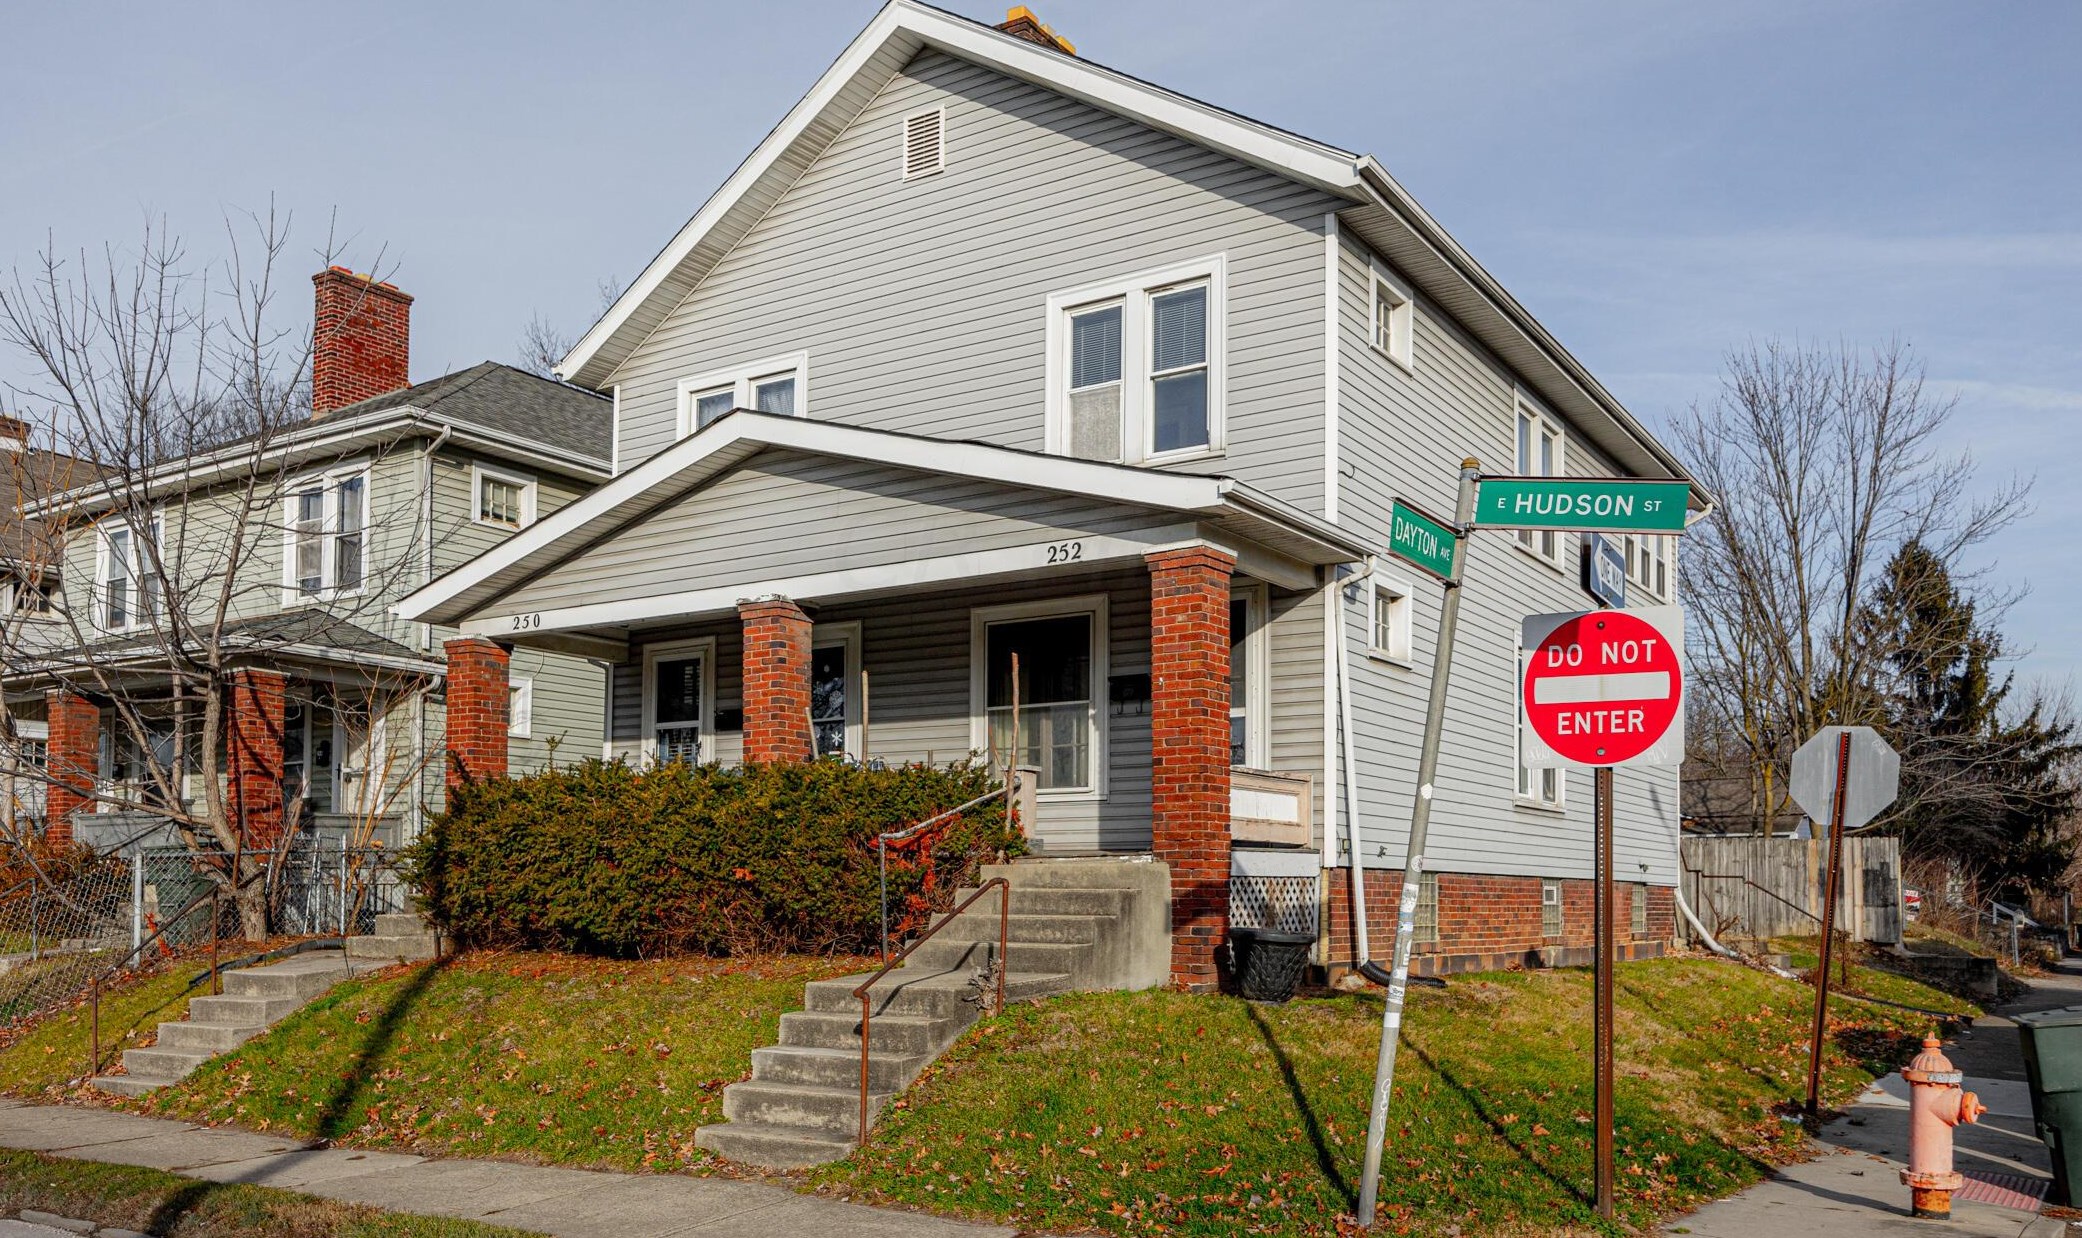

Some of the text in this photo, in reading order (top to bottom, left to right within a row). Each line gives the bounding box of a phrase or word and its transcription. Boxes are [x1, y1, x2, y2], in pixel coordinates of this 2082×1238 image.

[1497, 493, 1662, 516] E HUDSON ST
[1395, 516, 1451, 561] DAYTON AVE
[1047, 541, 1081, 564] 252
[512, 613, 540, 630] 250
[1548, 639, 1657, 668] DO NOT
[1557, 709, 1645, 735] ENTER
